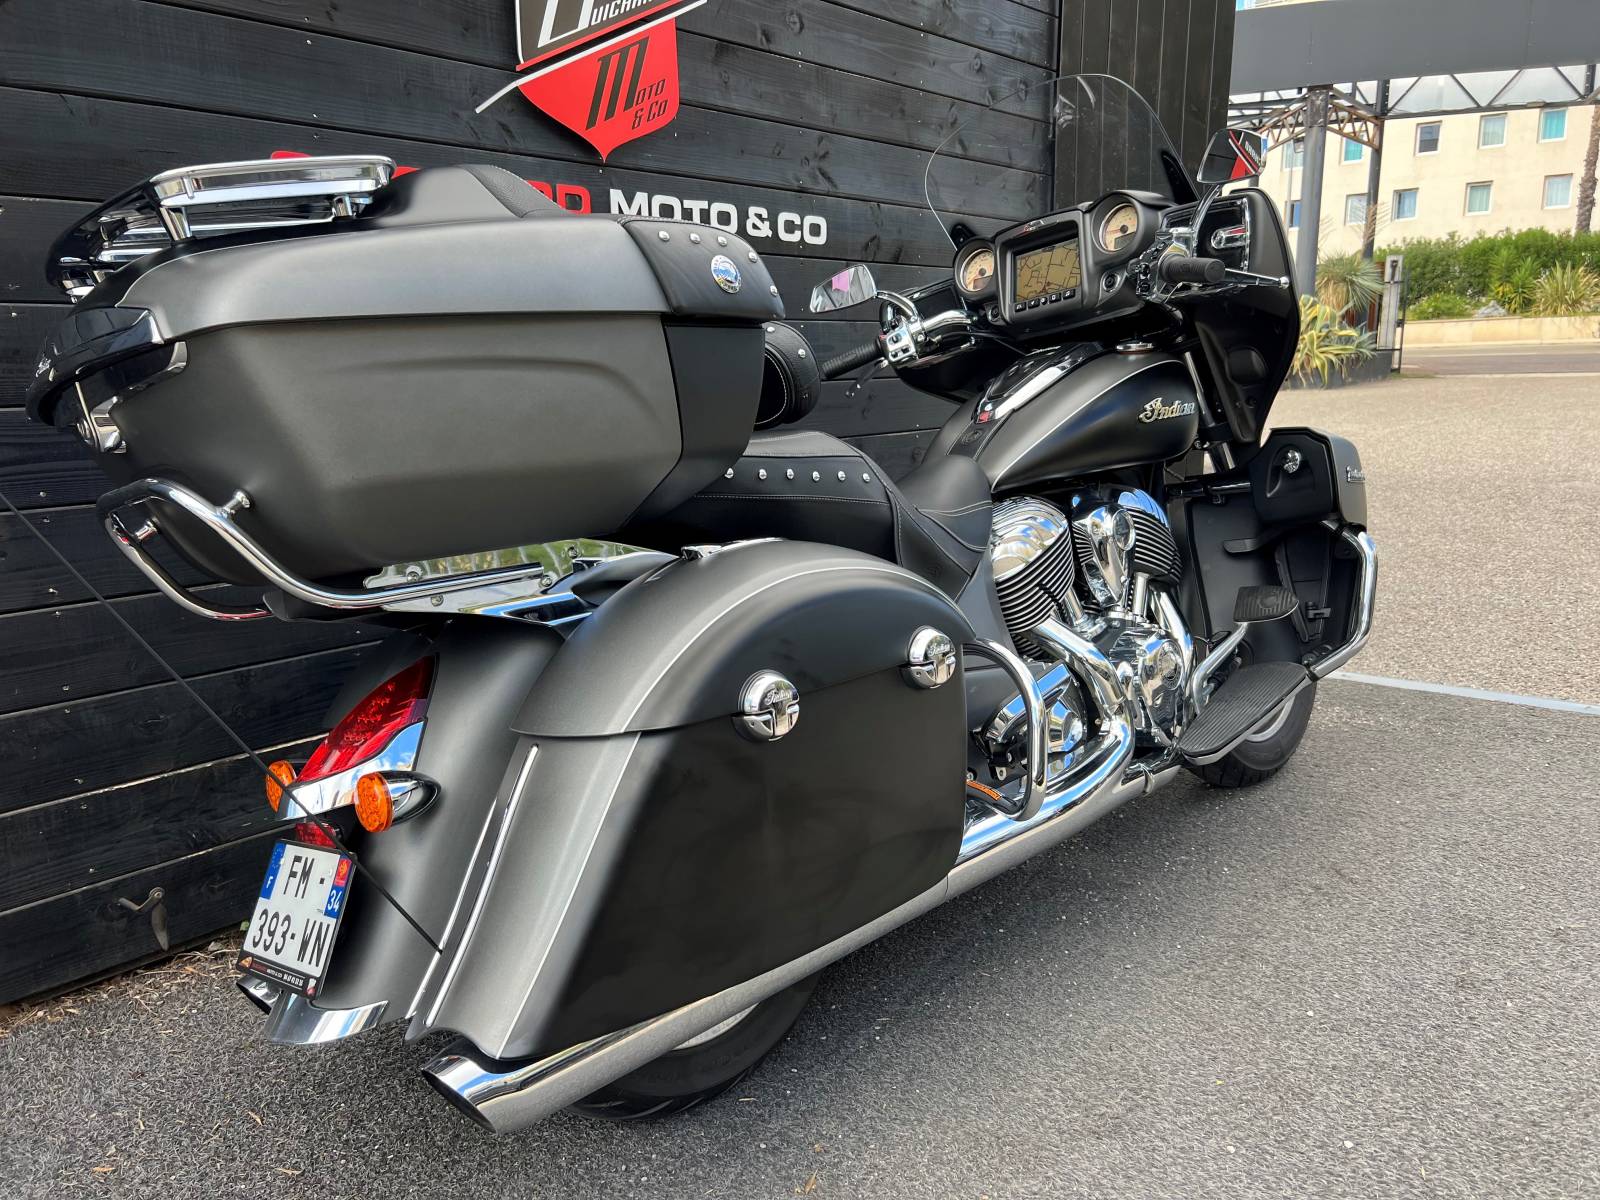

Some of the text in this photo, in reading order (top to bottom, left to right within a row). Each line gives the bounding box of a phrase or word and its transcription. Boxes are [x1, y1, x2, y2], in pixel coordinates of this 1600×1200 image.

[609, 188, 828, 246] MOTO & CO
[1139, 397, 1195, 422] Indian
[327, 889, 342, 912] 34
